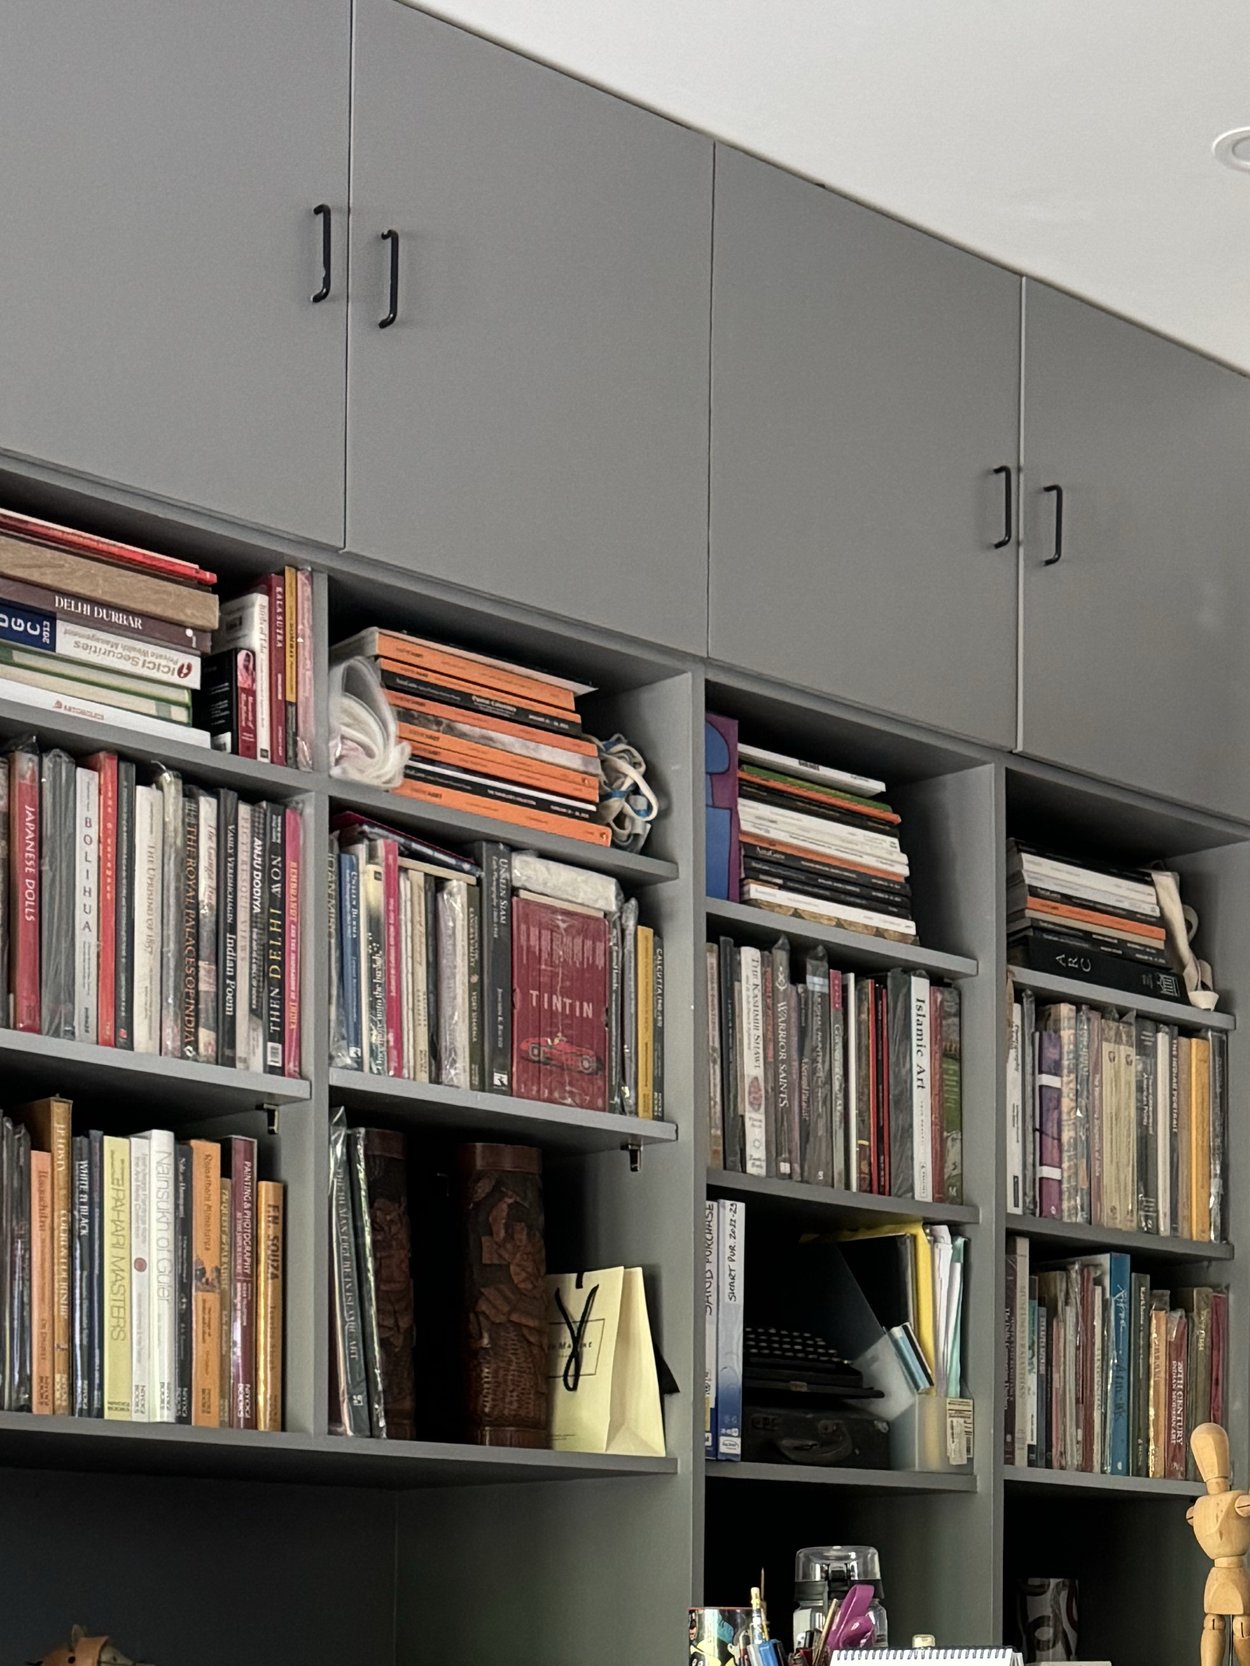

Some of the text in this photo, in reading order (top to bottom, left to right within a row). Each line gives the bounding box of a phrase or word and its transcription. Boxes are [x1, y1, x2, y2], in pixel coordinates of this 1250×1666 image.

[55, 595, 142, 630] DELHI DURBAR
[73, 639, 176, 676] ICICI Securities
[187, 825, 196, 859] THE
[227, 825, 235, 855] VASILY
[24, 805, 36, 922] JAPANESE DOLLS
[185, 860, 196, 905] ROYAL
[252, 838, 262, 913] ANJU DODIYA
[270, 855, 282, 898] NOW
[288, 861, 298, 922] REMBRANDT
[499, 859, 508, 924] UNSEEN SIAM
[184, 910, 196, 973] PALACES
[226, 933, 236, 976] Indian
[269, 908, 282, 1033] THEN DELHI
[225, 979, 236, 1016] Poem
[288, 1001, 297, 1029] INDIA
[529, 990, 593, 1018] TINTIN
[752, 983, 761, 1030] KASHMIR
[184, 999, 194, 1042] INDIA
[753, 1033, 761, 1069] SHAWL
[777, 1001, 789, 1108] WARRIOR SAINTS
[916, 998, 926, 1090] Islamic Art
[79, 1160, 89, 1191] WHITE
[243, 1161, 251, 1200] PAINTING
[80, 1205, 88, 1236] BLACK
[155, 1150, 173, 1304] Nainsukh of Guler
[110, 1187, 126, 1341] PAHARI MASTERS
[243, 1211, 251, 1275] PHOTOGRAPHY
[267, 1235, 279, 1281] SOUZA
